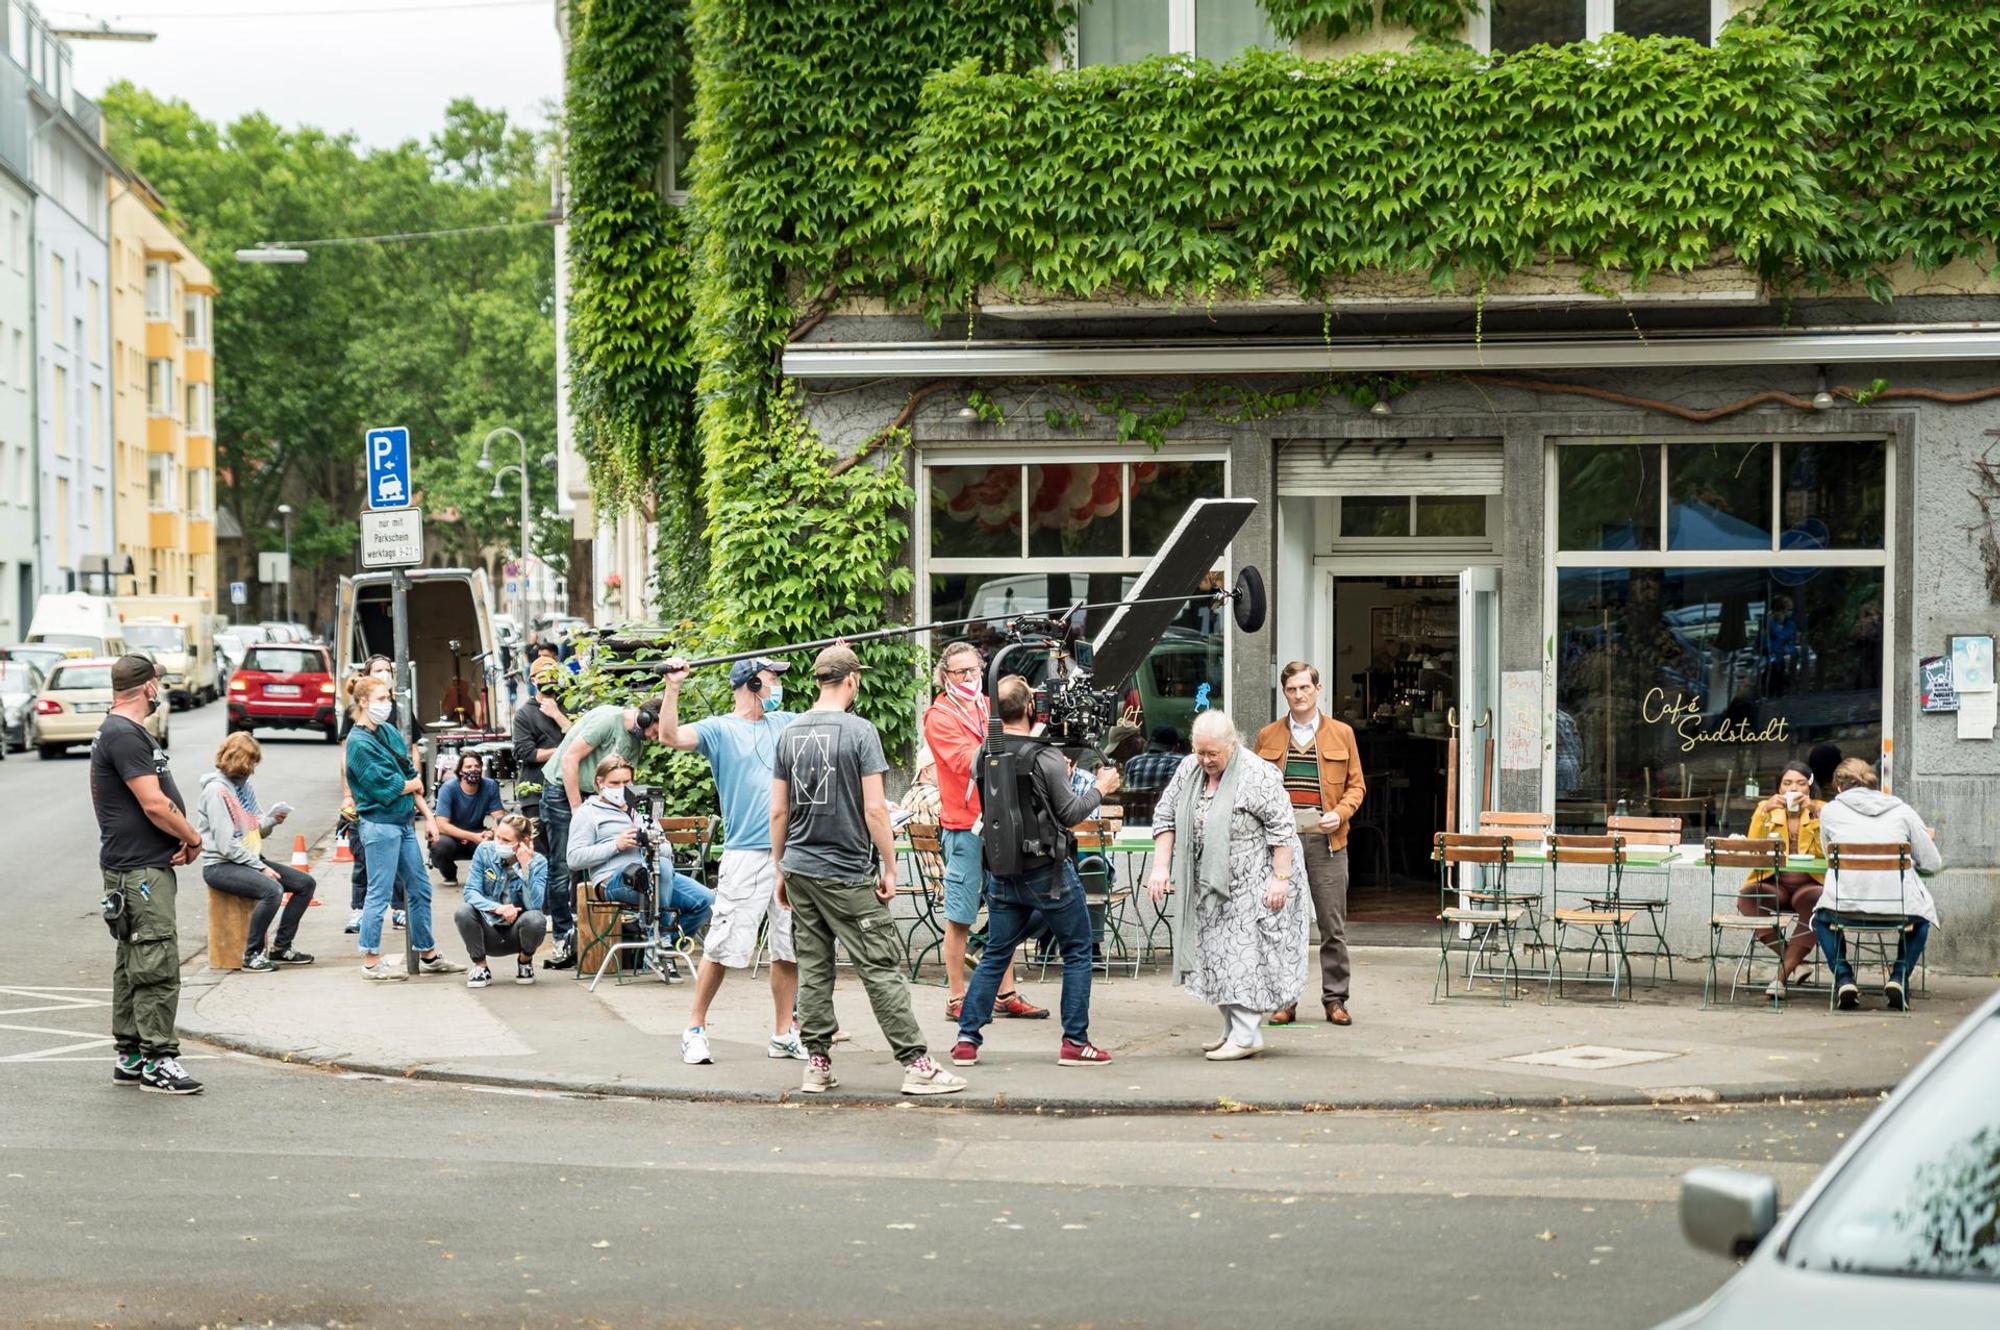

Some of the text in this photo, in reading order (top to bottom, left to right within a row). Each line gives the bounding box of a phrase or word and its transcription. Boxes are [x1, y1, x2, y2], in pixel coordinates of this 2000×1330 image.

[373, 436, 392, 470] P
[378, 518, 404, 528] nur mit
[374, 533, 409, 544] Parkschein
[367, 549, 397, 560] werktags
[1642, 687, 1700, 724] Café
[1677, 714, 1789, 752] Südstadt
